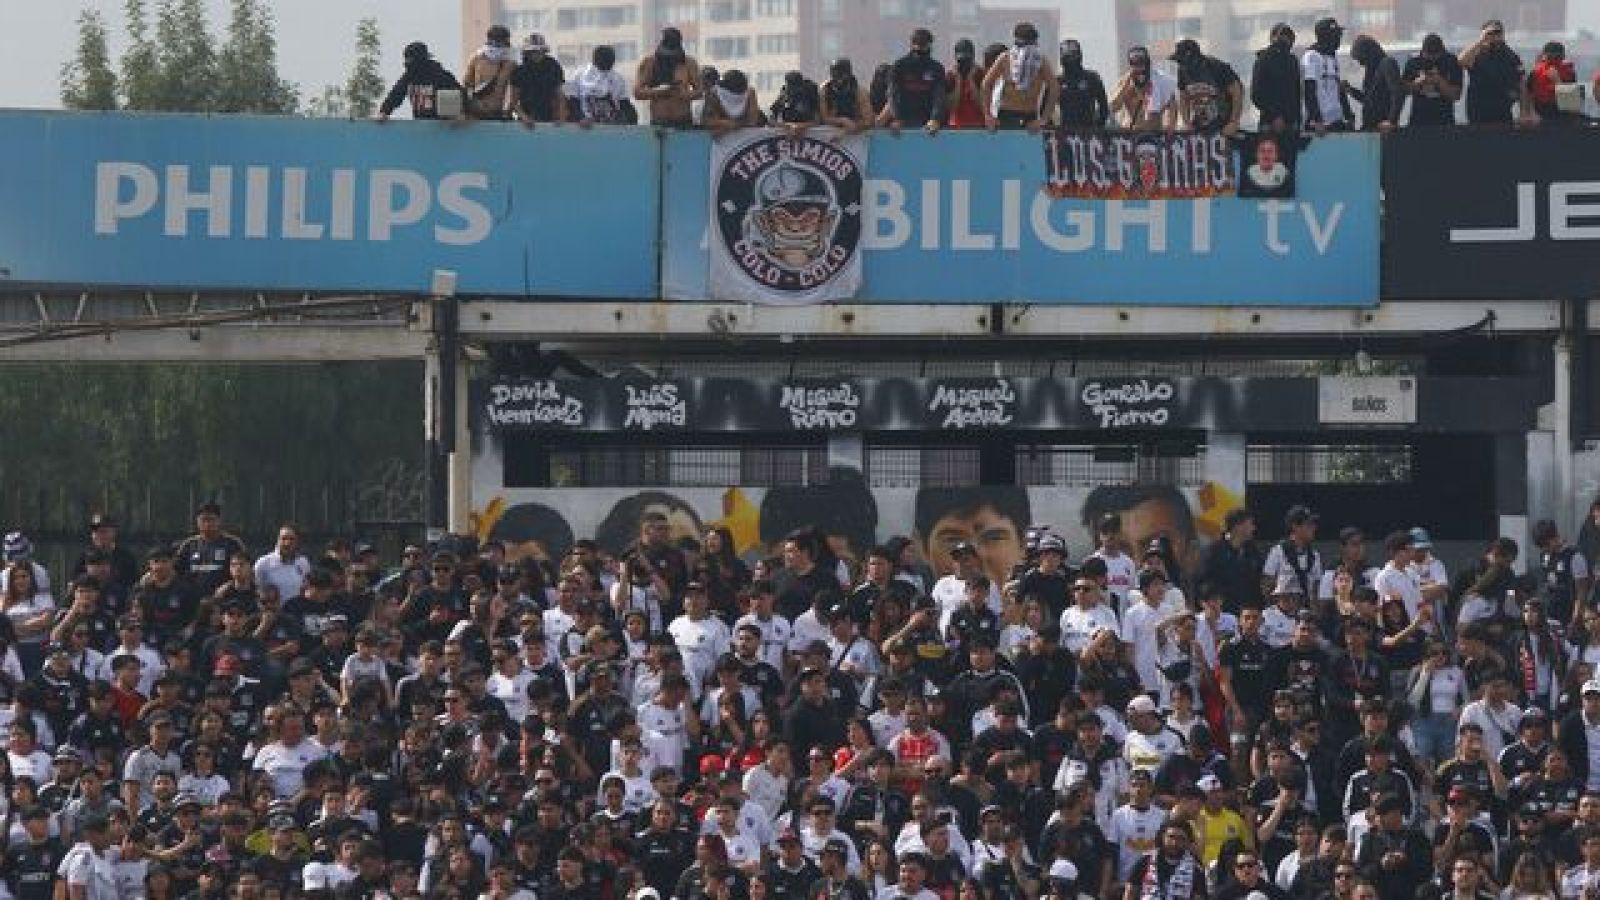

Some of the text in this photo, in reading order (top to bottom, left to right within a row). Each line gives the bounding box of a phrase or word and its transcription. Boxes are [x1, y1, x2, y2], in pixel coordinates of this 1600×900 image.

[730, 139, 853, 180] THE SIMIOS
[95, 161, 493, 245] PHILIPS
[699, 178, 1212, 252] BILIGHT
[734, 240, 781, 284] COLO
[490, 380, 560, 405] David
